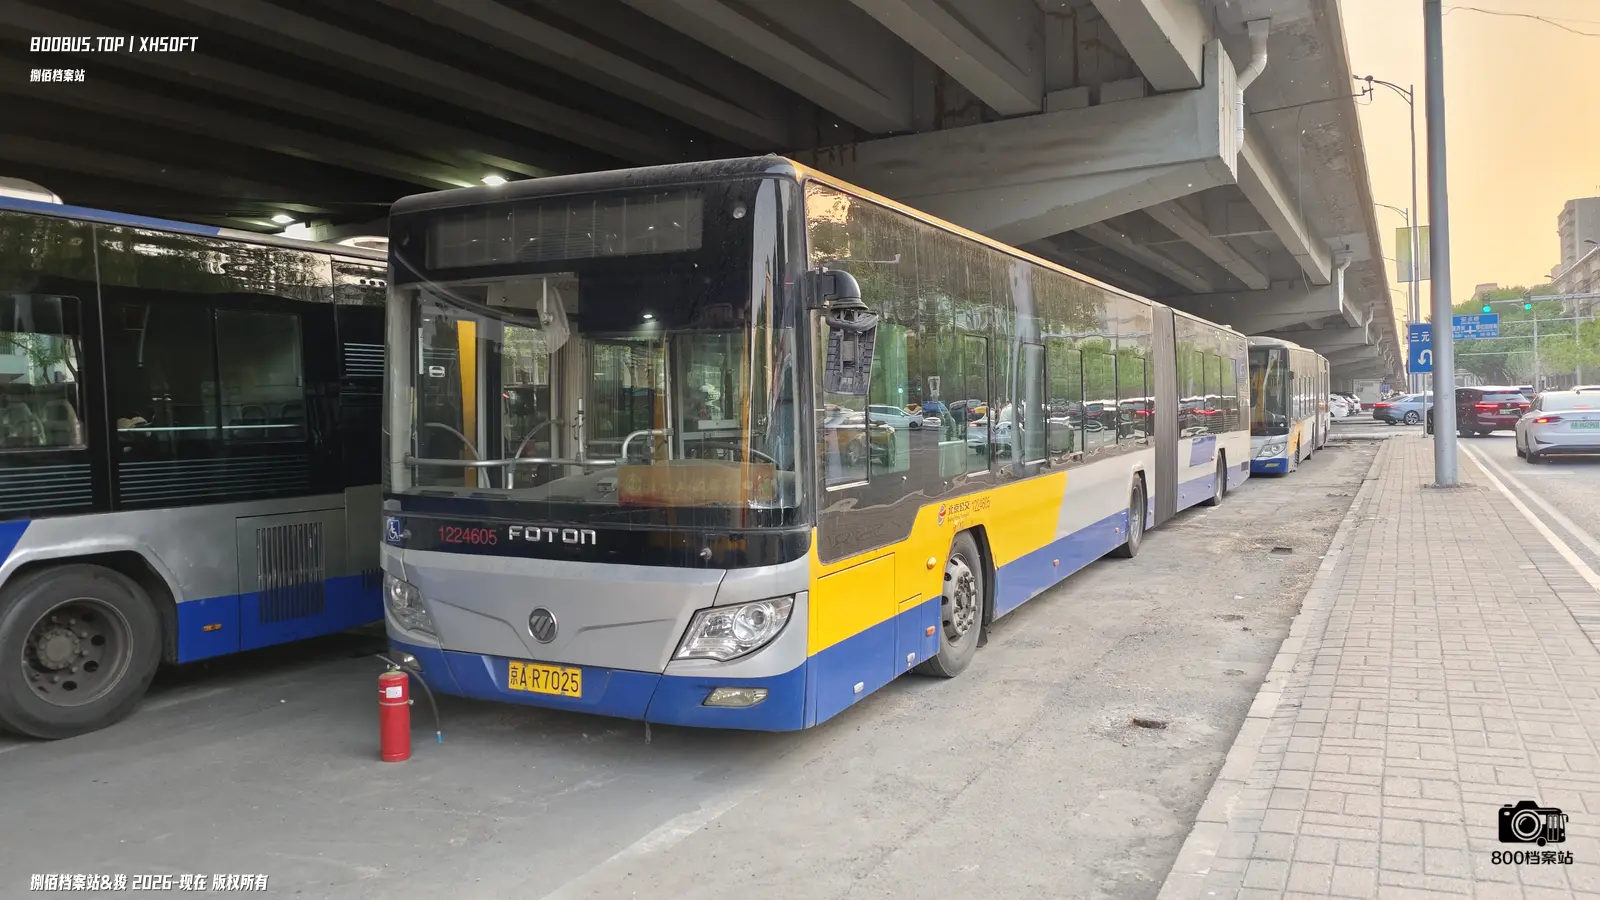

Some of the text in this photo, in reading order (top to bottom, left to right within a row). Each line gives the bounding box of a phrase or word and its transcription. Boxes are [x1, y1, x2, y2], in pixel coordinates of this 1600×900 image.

[1410, 331, 1431, 343] 三元
[438, 525, 498, 546] 1224605
[508, 525, 597, 545] FOTON
